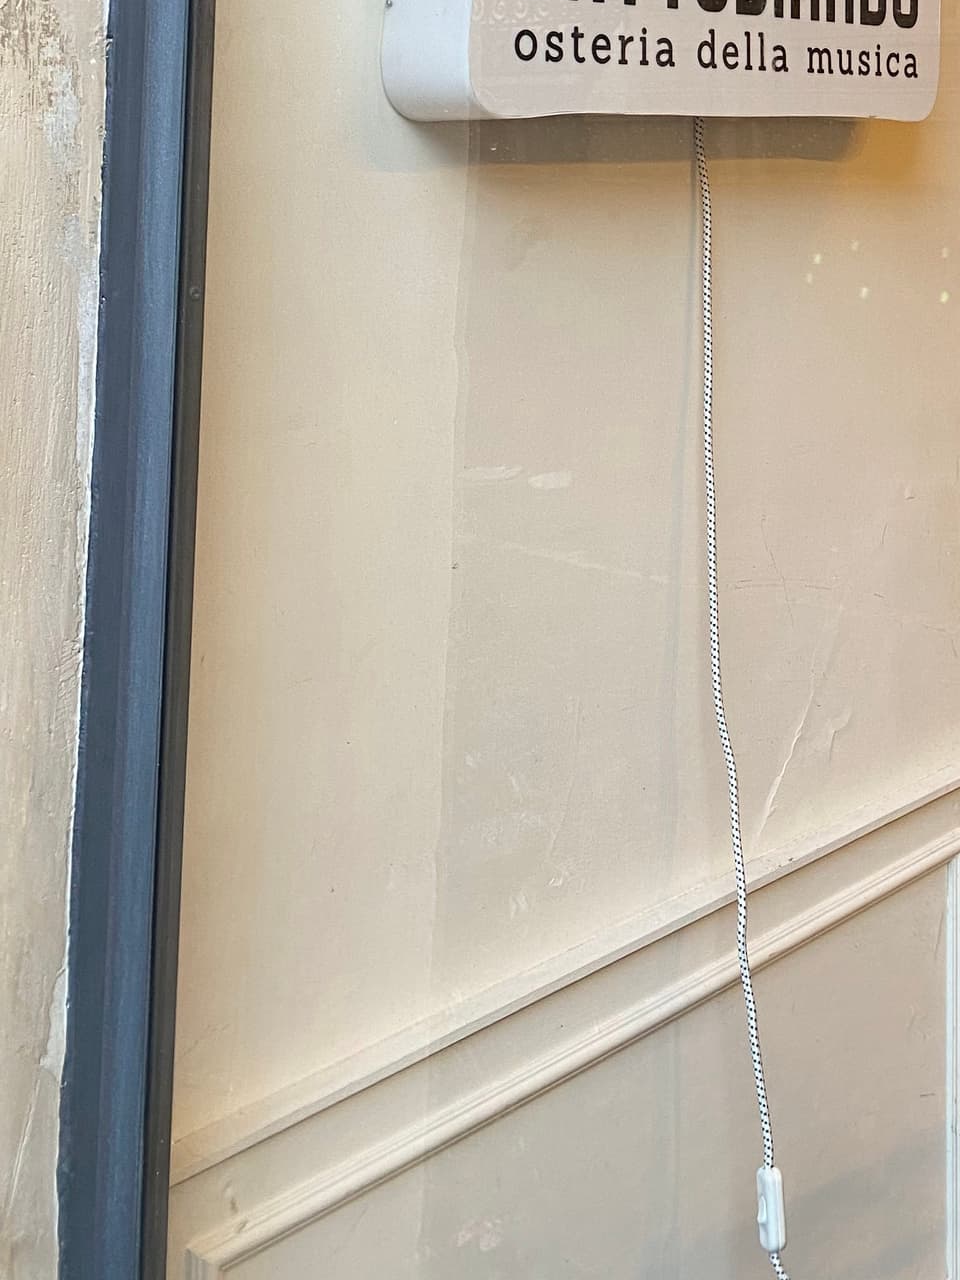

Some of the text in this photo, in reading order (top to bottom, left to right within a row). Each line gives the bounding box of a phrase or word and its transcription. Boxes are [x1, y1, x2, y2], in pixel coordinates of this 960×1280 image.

[514, 26, 919, 79] osteria della musica
